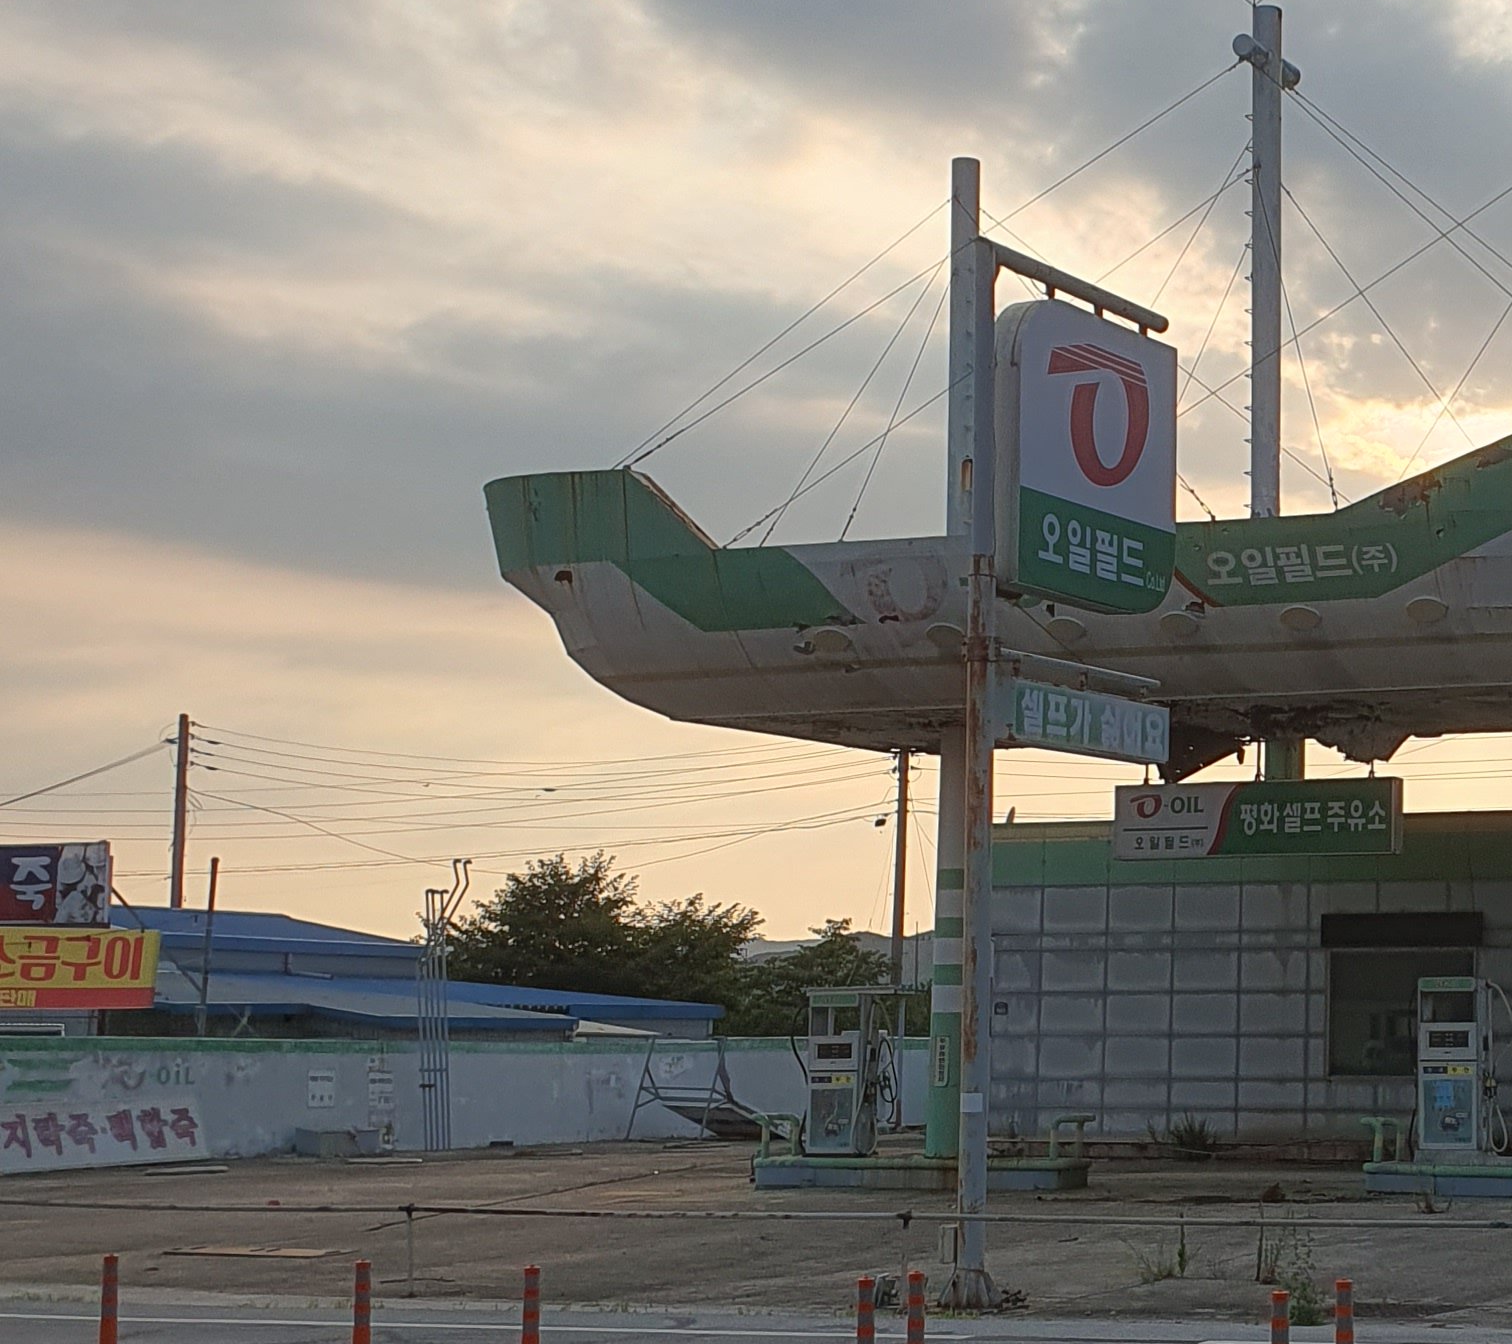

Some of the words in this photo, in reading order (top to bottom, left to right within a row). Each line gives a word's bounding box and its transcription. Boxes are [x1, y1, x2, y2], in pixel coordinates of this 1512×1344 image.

[1038, 513, 1144, 586] 오일필드
[1207, 543, 1398, 586] 오일필드(주)
[1021, 688, 1092, 746] 셀프가
[10, 856, 52, 910] 죽
